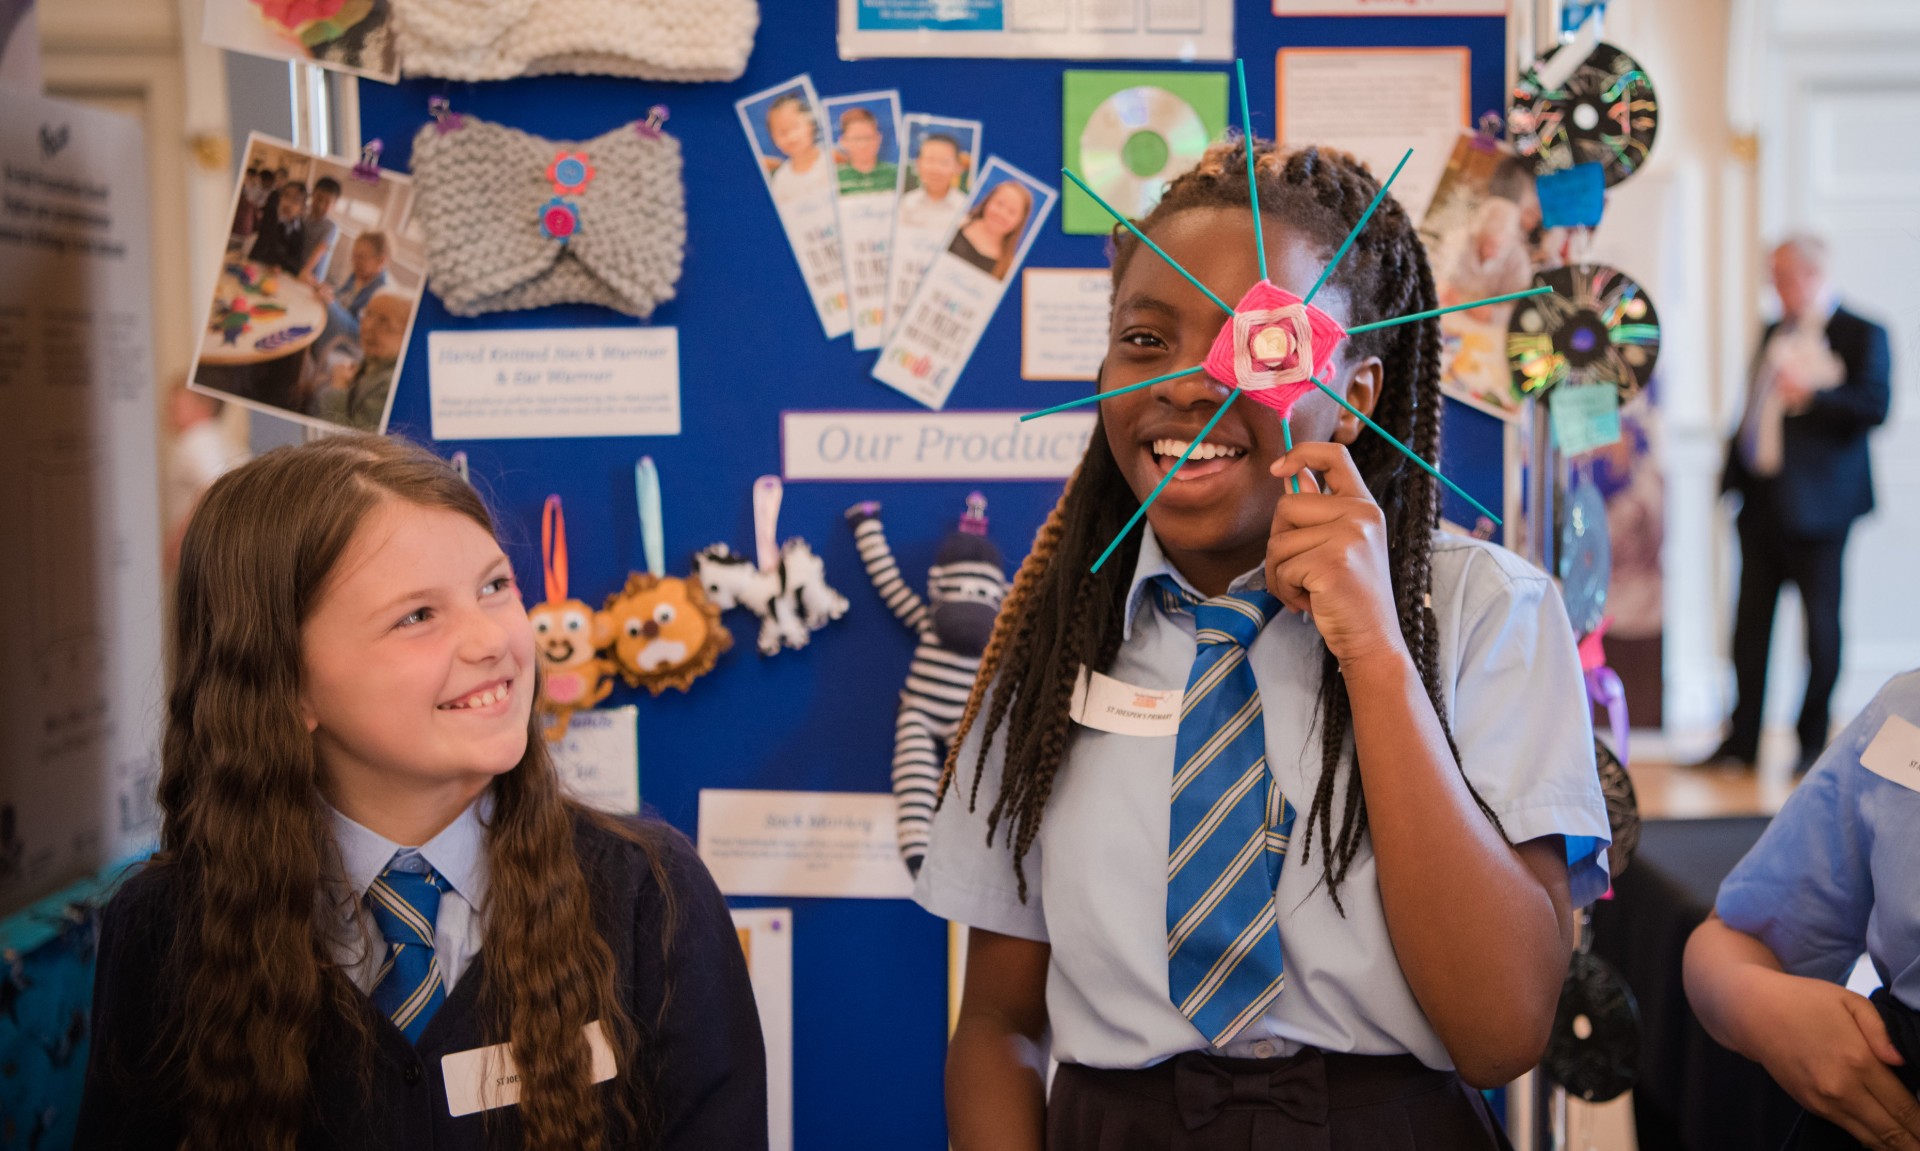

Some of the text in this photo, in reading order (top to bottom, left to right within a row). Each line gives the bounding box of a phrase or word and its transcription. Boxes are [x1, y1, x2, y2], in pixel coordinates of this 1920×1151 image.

[817, 420, 1091, 463] Our Product
[496, 1077, 505, 1087] ST
